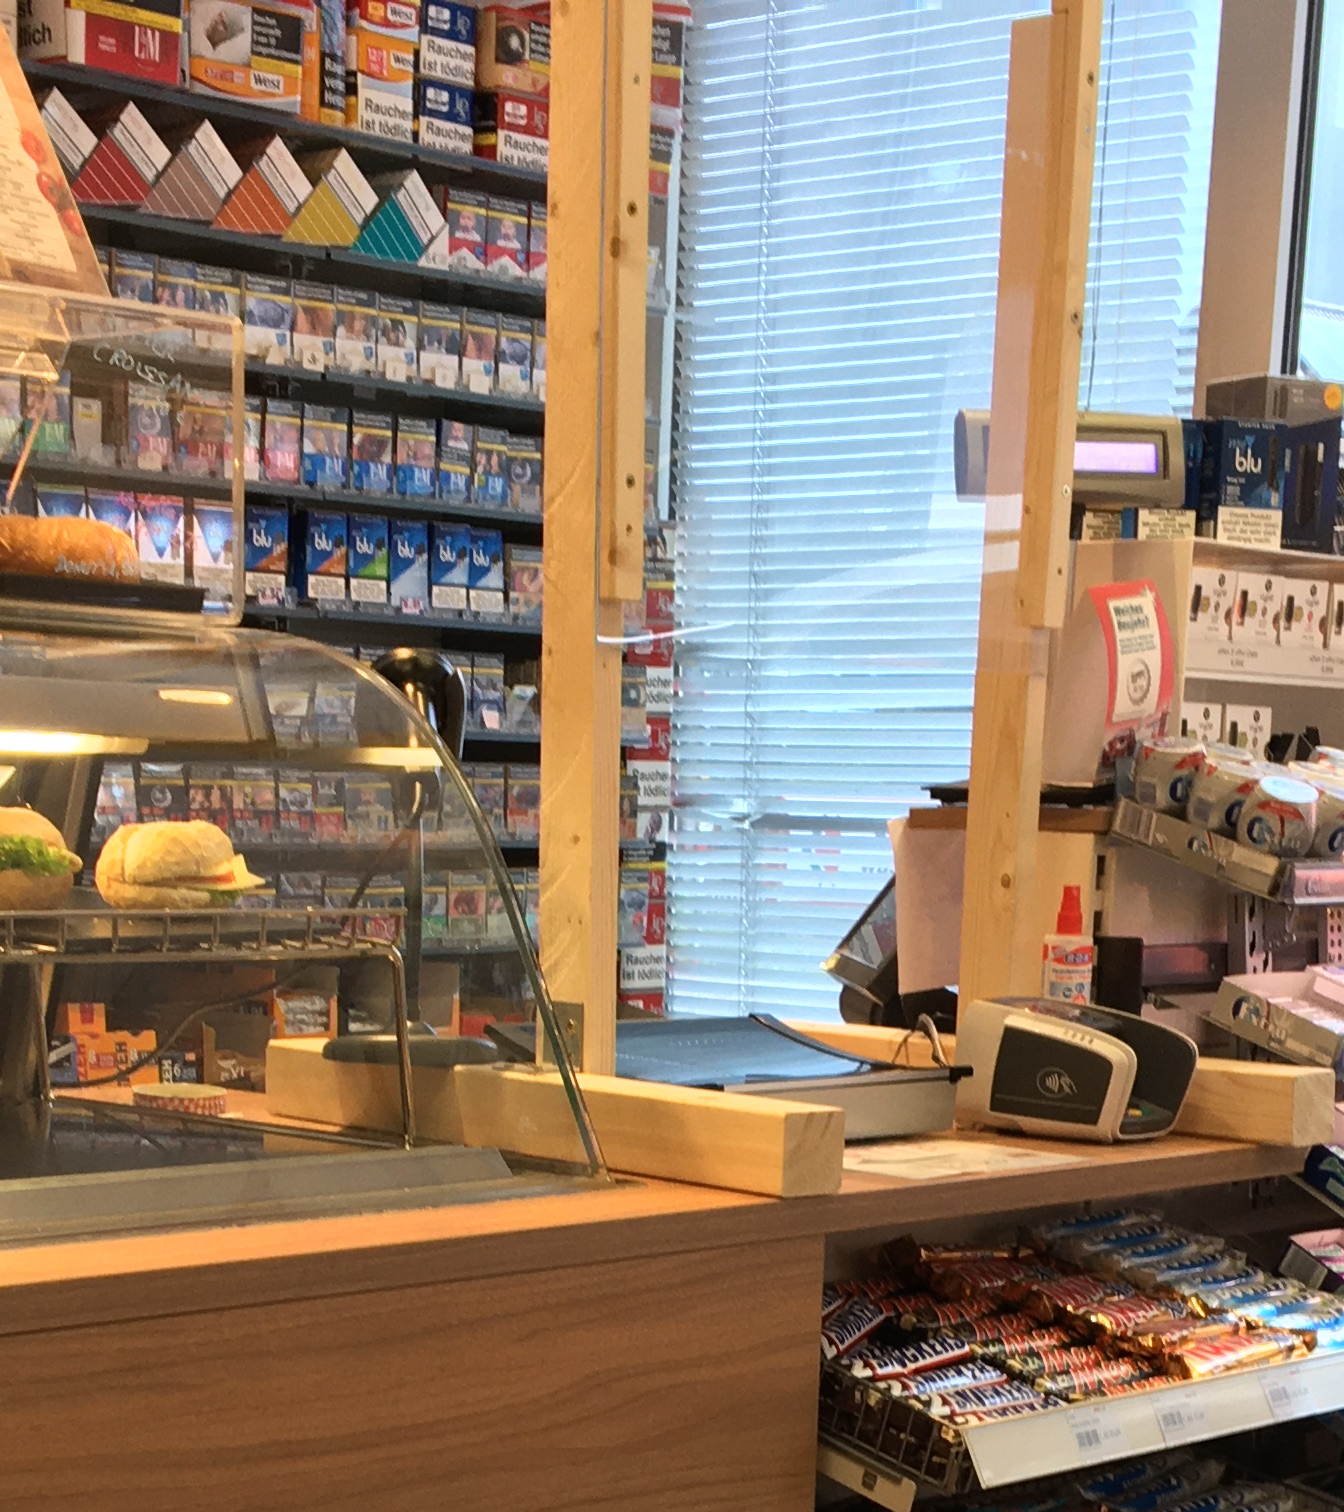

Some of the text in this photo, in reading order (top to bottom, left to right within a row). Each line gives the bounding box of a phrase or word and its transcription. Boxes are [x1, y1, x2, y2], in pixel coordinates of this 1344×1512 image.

[388, 5, 416, 26] West
[251, 71, 284, 92] West
[378, 119, 412, 140] tödlic
[1235, 446, 1262, 474] blu
[252, 528, 272, 548] blu
[314, 532, 334, 552] blu
[355, 535, 376, 556] blu
[397, 539, 416, 560] blu
[439, 544, 458, 564] blu
[472, 548, 492, 568] blu
